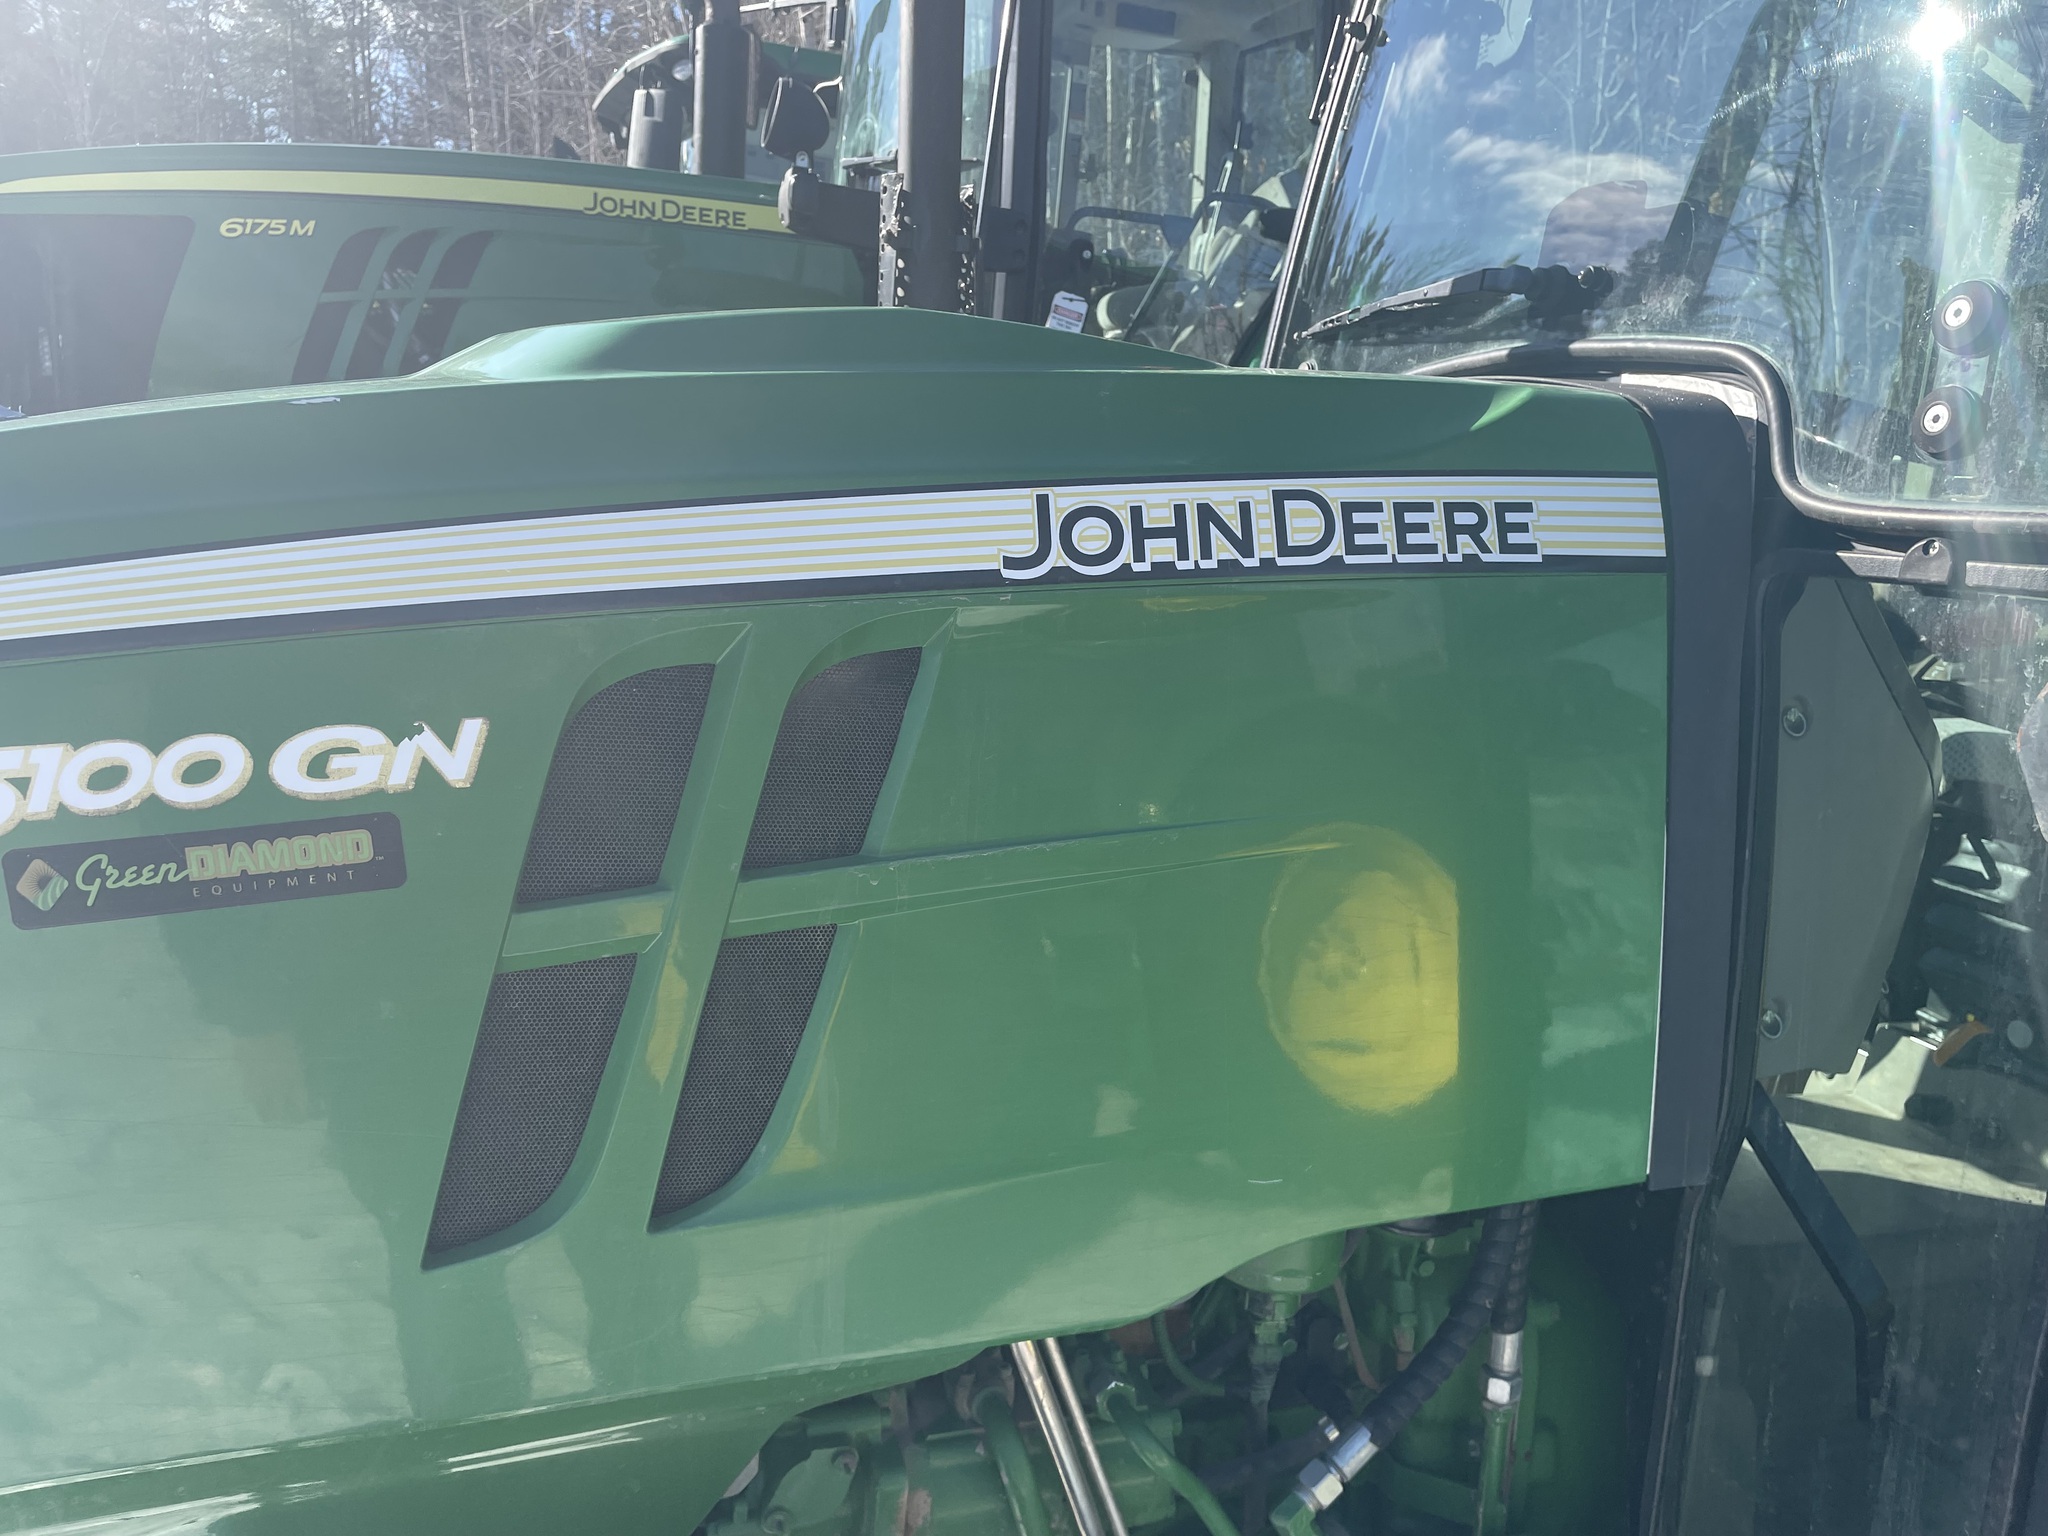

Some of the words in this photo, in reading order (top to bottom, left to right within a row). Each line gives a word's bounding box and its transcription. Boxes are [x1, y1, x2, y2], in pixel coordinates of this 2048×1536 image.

[219, 217, 288, 239] 6175
[289, 219, 317, 237] M
[583, 191, 657, 220] JOHN
[661, 199, 748, 229] DEERE
[1000, 491, 1260, 580] JOHN
[1268, 485, 1543, 566] DEERE
[268, 716, 490, 801] GN
[74, 853, 192, 907] Green
[185, 829, 373, 881] DIAMOND
[192, 869, 355, 898] EQUIPMENT
